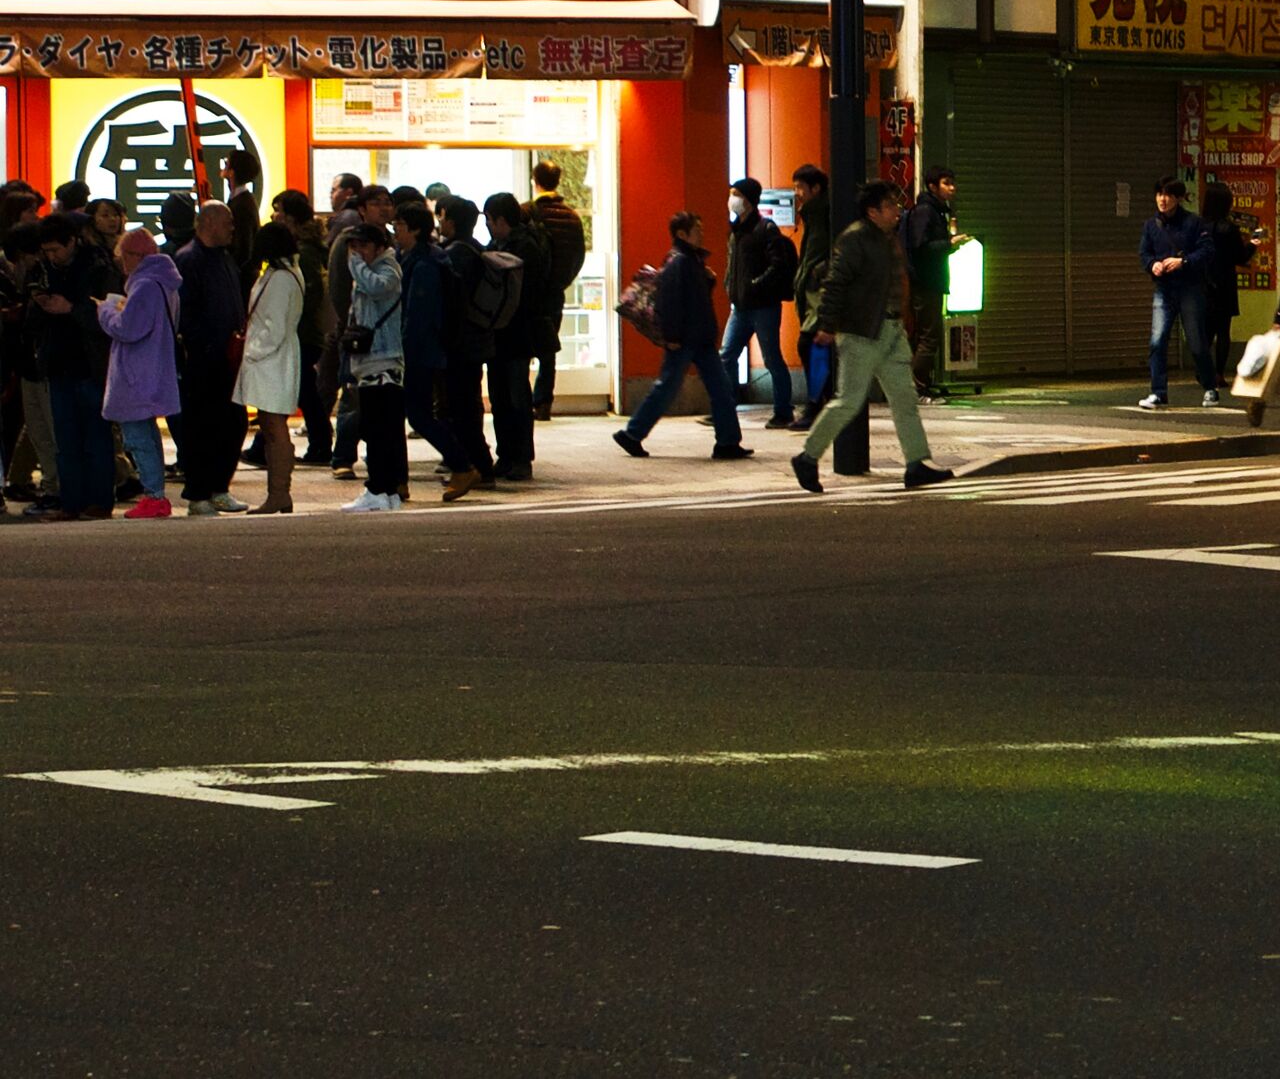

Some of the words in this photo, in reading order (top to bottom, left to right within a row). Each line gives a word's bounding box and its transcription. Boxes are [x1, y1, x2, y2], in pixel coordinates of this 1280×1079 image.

[539, 36, 687, 75] 無料査定
[1204, 152, 1220, 166] TAX
[1221, 153, 1241, 166] FREE
[1241, 152, 1265, 166] SHOP
